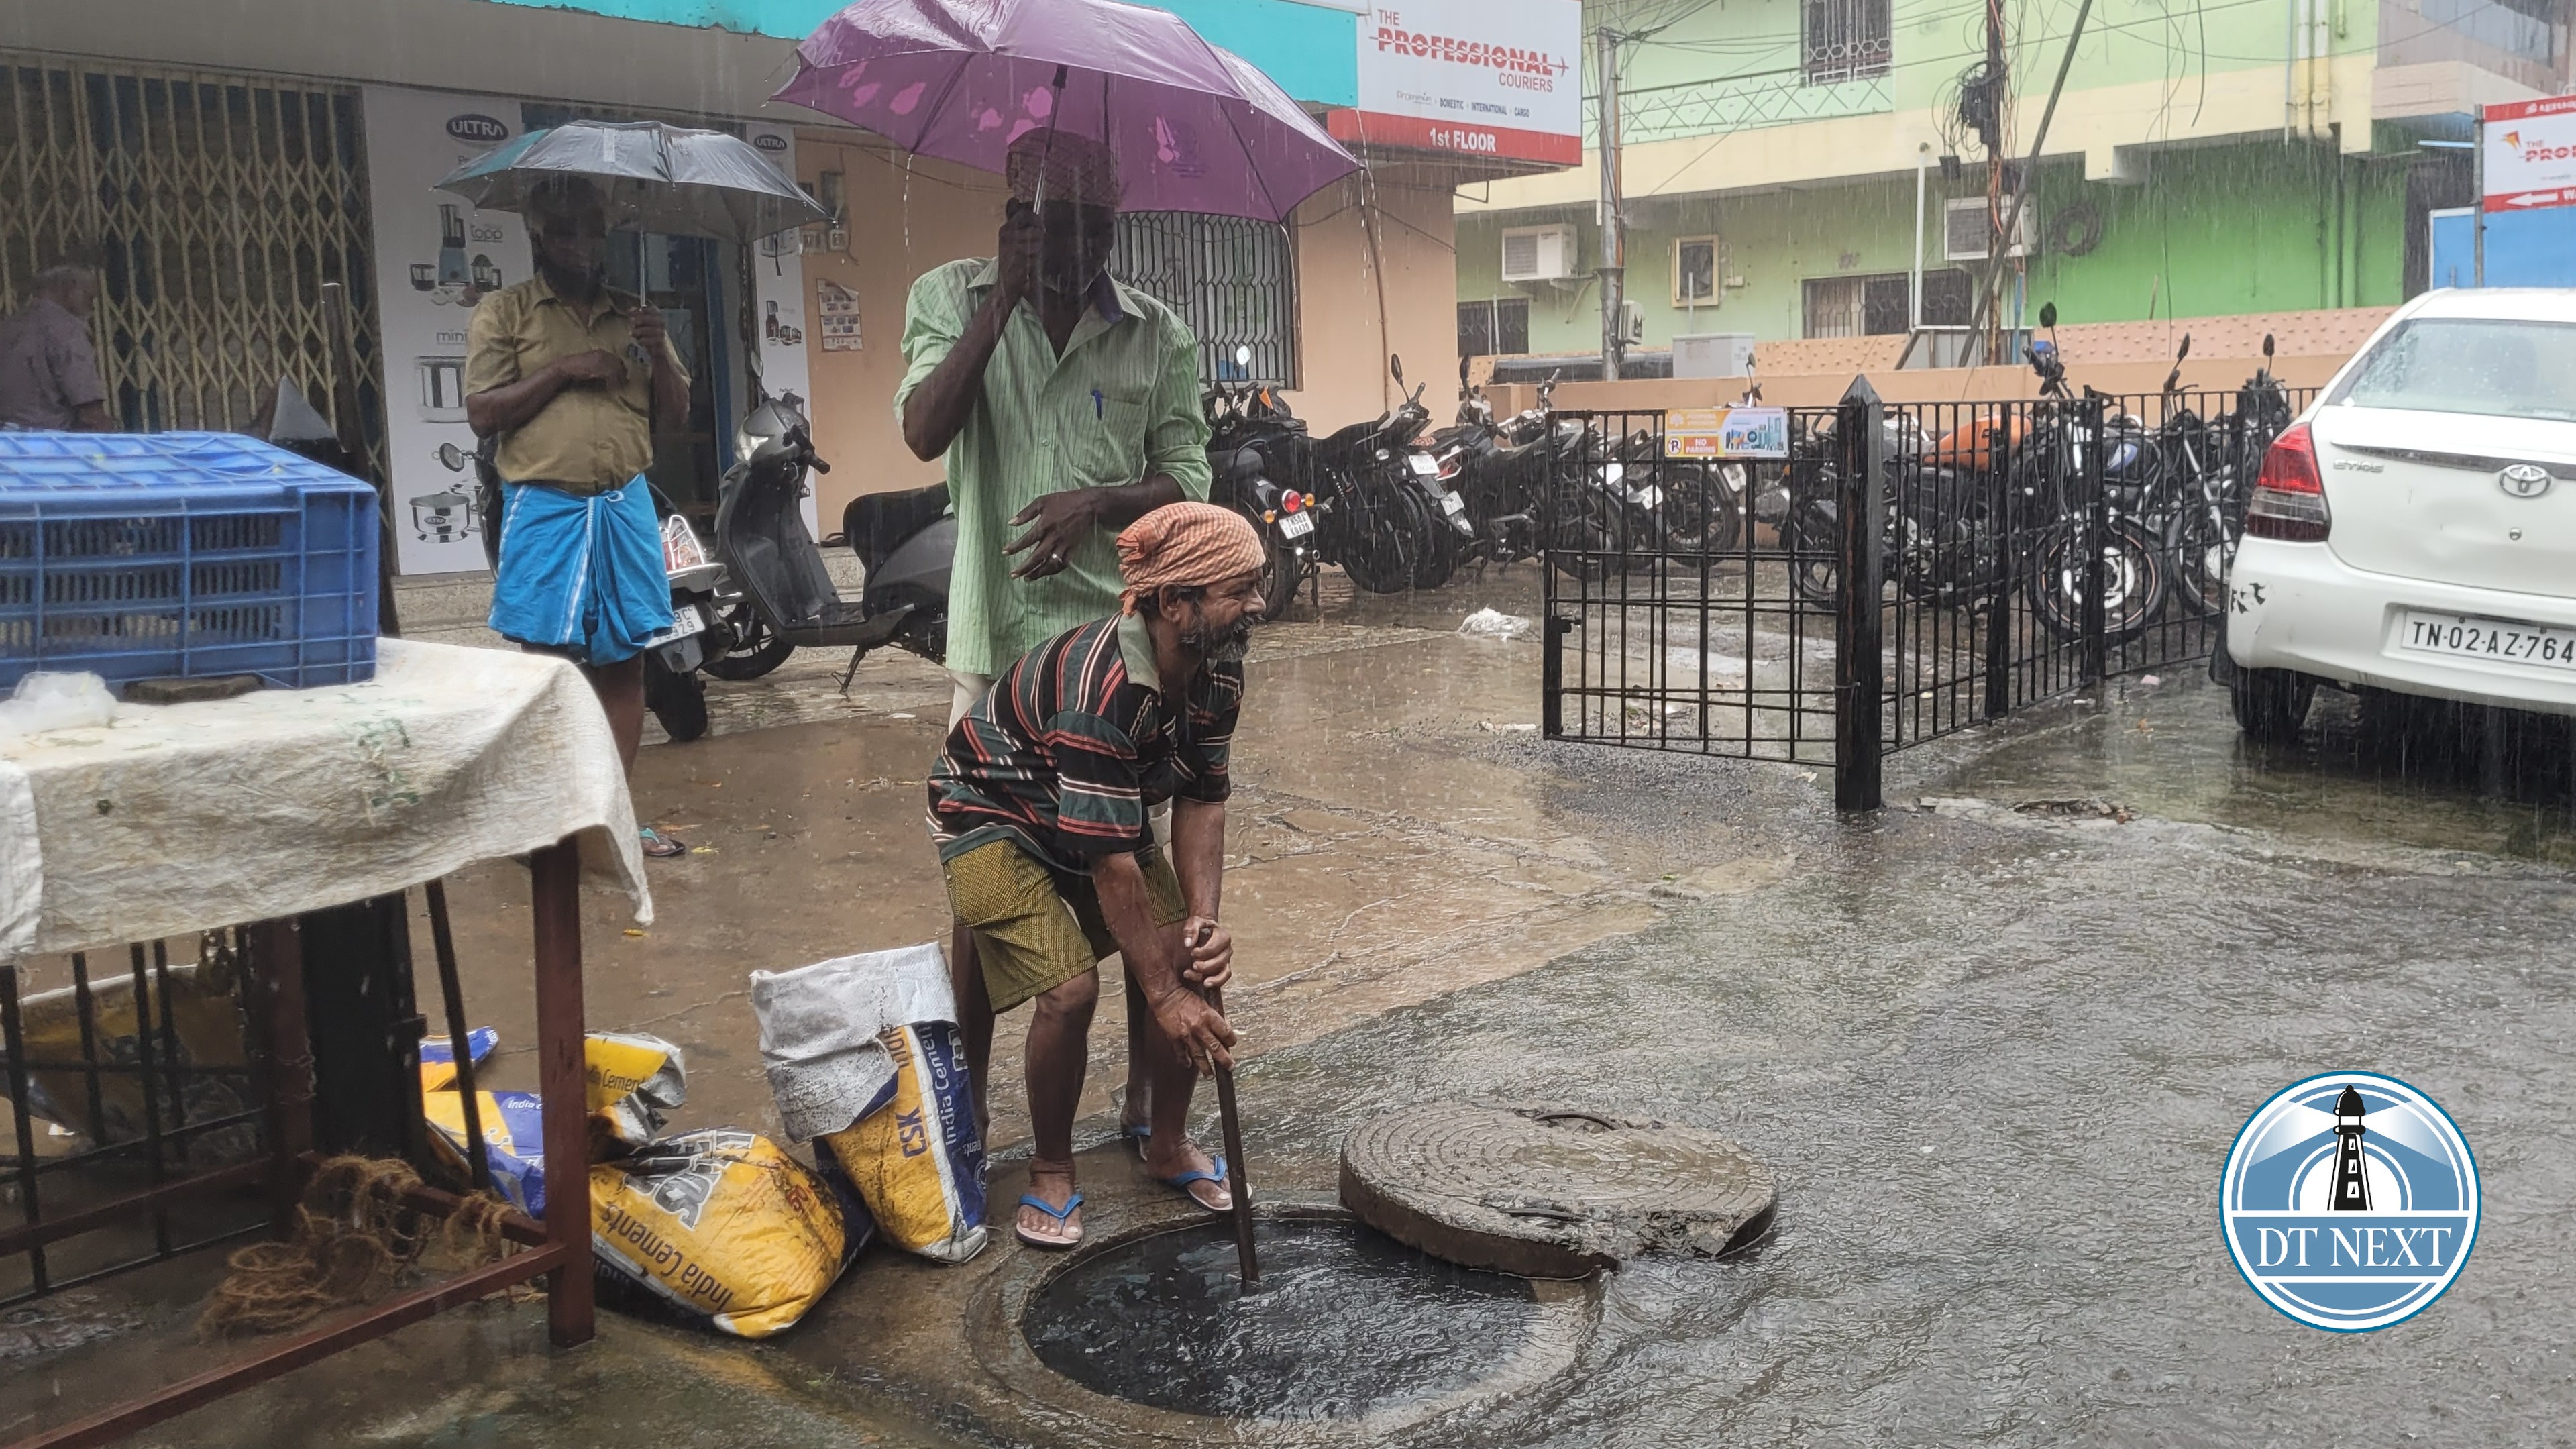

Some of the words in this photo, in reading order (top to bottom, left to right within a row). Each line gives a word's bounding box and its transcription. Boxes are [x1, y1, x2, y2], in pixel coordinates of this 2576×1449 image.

[1378, 9, 1400, 26] THE
[1378, 27, 1553, 76] PROFESSIONAL
[1499, 72, 1553, 93] COURIERS
[1440, 97, 1464, 110] DOMESTIC
[1471, 103, 1508, 115] INTERNATIONAL
[1514, 107, 1530, 118] CARGO
[451, 119, 504, 136] ULTRA
[757, 138, 785, 148] ULTRA
[1430, 128, 1450, 147] 1st
[1453, 131, 1496, 152] FLOOR
[1685, 445, 1717, 454] PARKING
[1695, 437, 1707, 447] NO
[507, 1099, 536, 1109] India
[941, 1094, 957, 1146] India
[896, 1105, 929, 1159] CSK
[602, 1204, 683, 1275] Cements
[682, 1263, 734, 1312] India
